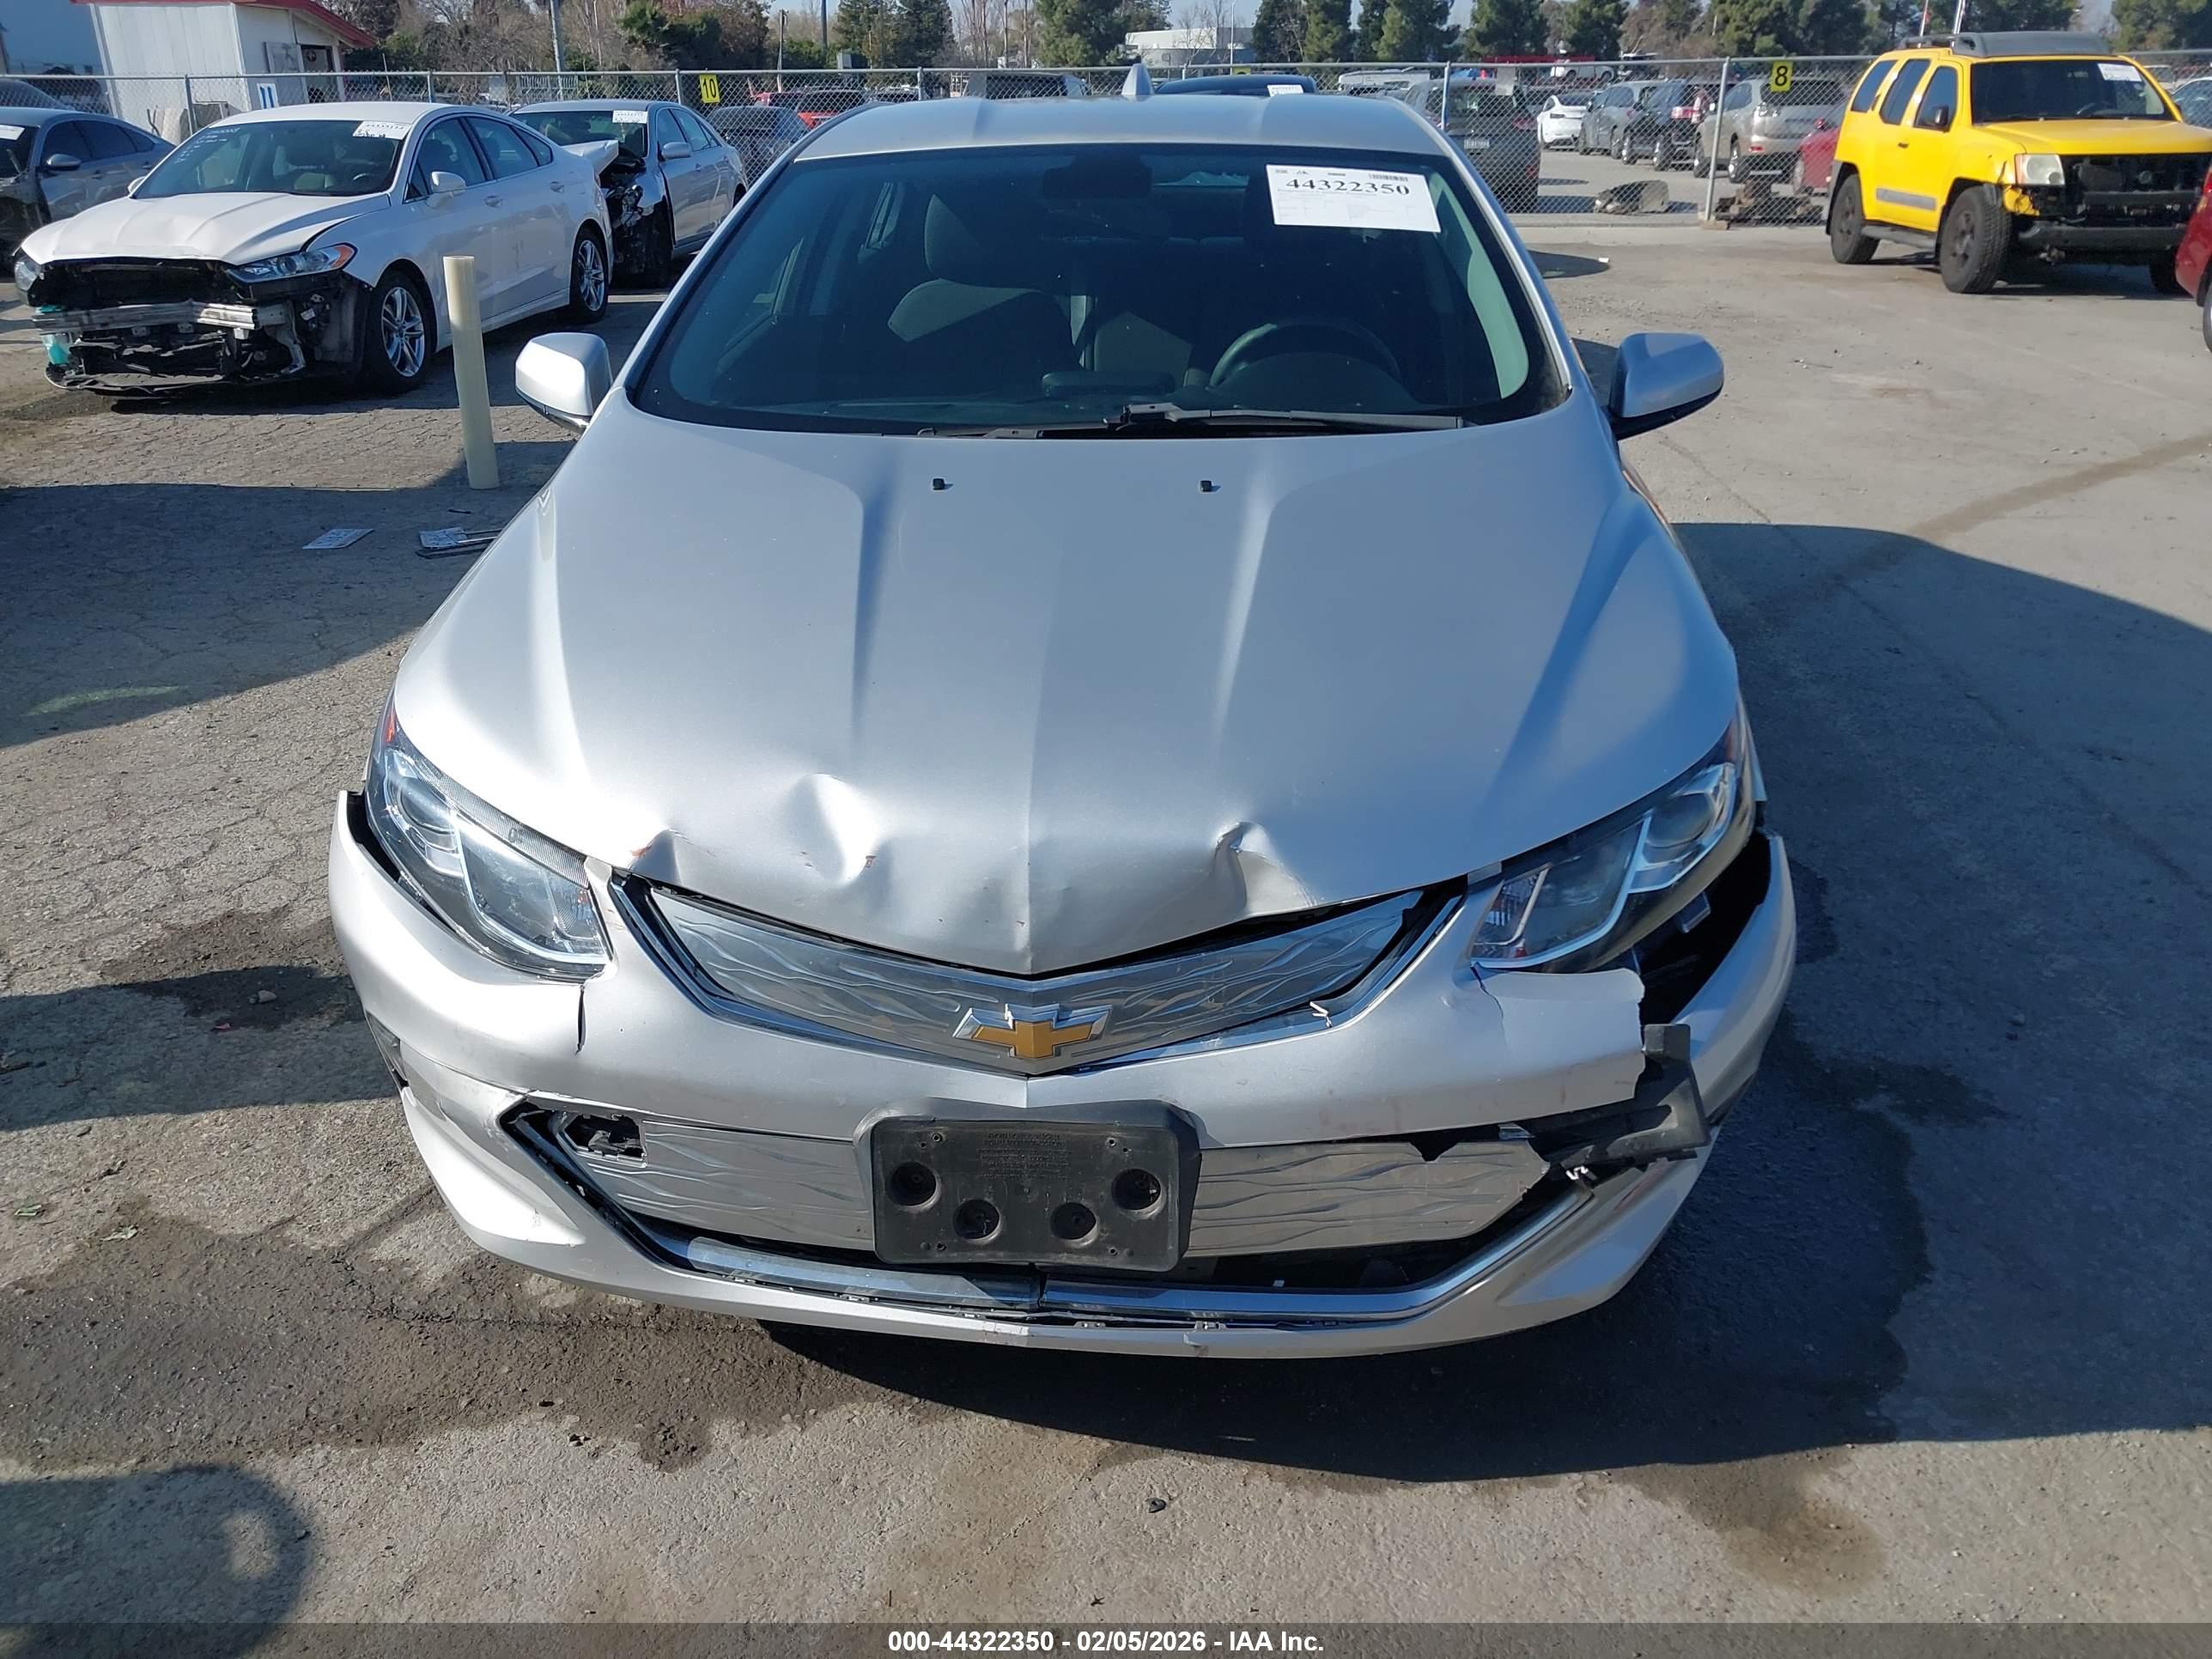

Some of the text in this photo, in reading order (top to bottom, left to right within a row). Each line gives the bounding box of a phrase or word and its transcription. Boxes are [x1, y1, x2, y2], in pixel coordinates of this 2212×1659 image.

[1774, 65, 1789, 87] 8
[702, 78, 717, 99] 10
[1285, 179, 1410, 196] 44322350
